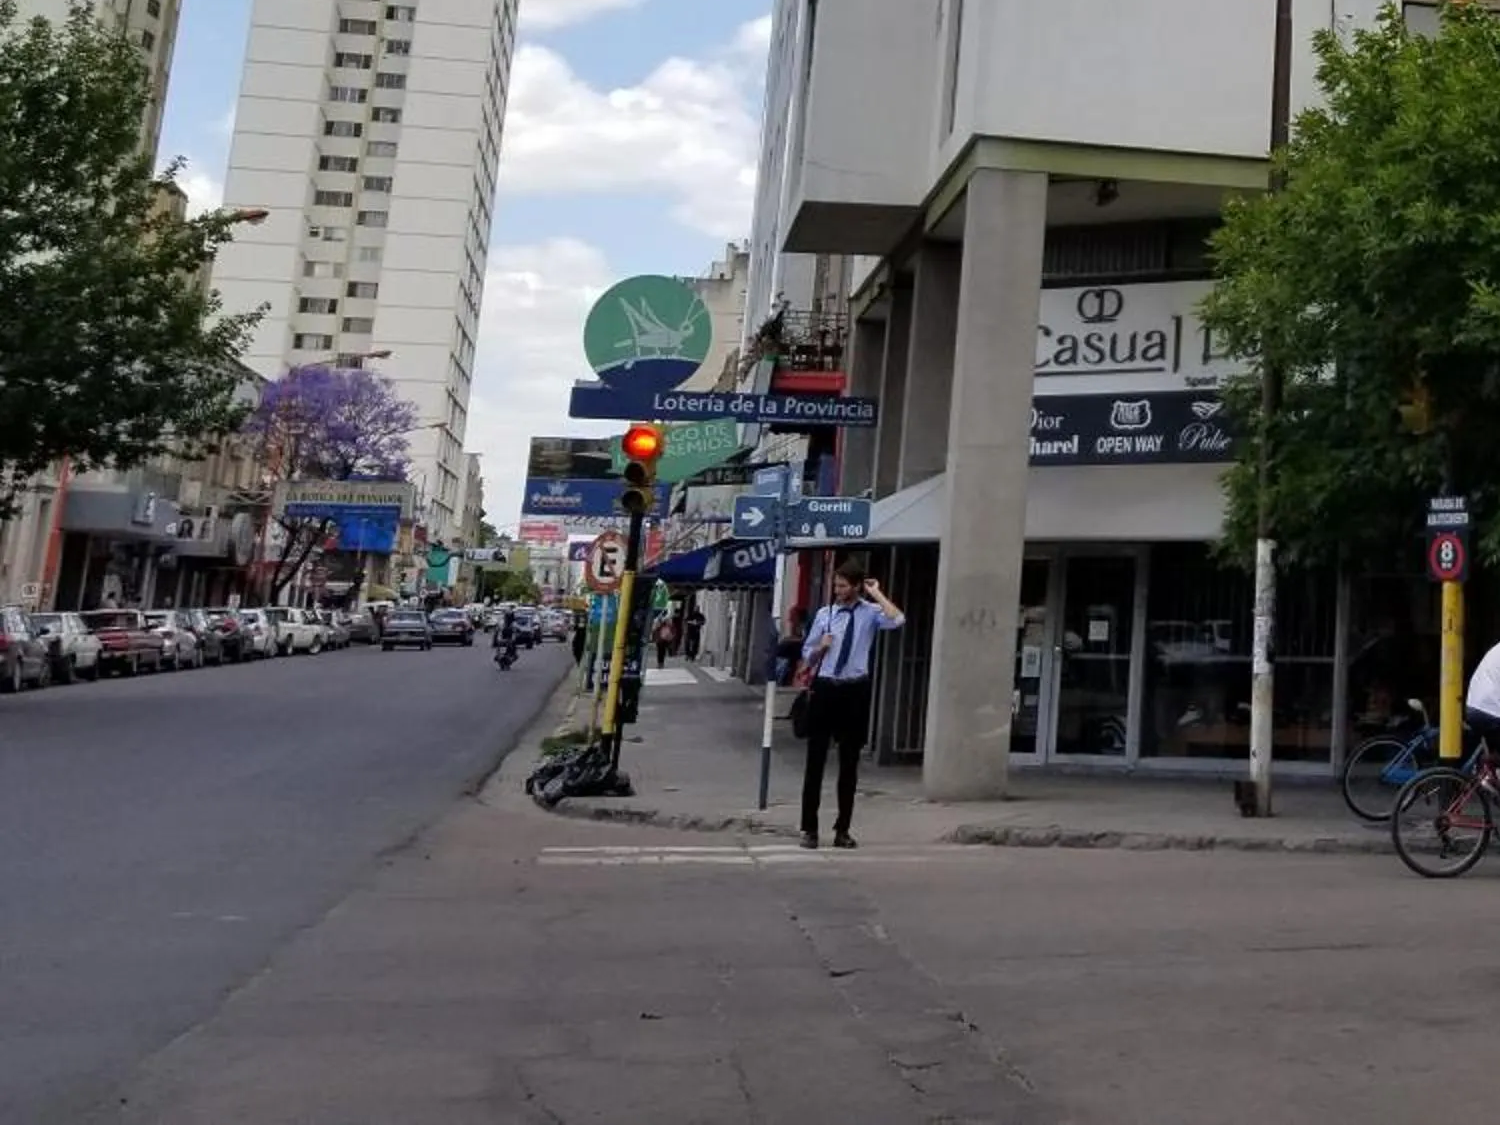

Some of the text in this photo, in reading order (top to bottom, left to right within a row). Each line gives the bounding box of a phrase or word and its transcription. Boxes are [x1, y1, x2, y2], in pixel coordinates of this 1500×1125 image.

[654, 394, 874, 418] Lotería de la Provincia
[1029, 434, 1079, 455] harel
[1097, 435, 1164, 453] OPEN WAY
[808, 500, 852, 512] Gorriti
[801, 523, 863, 536] 0 100
[599, 546, 617, 577] E
